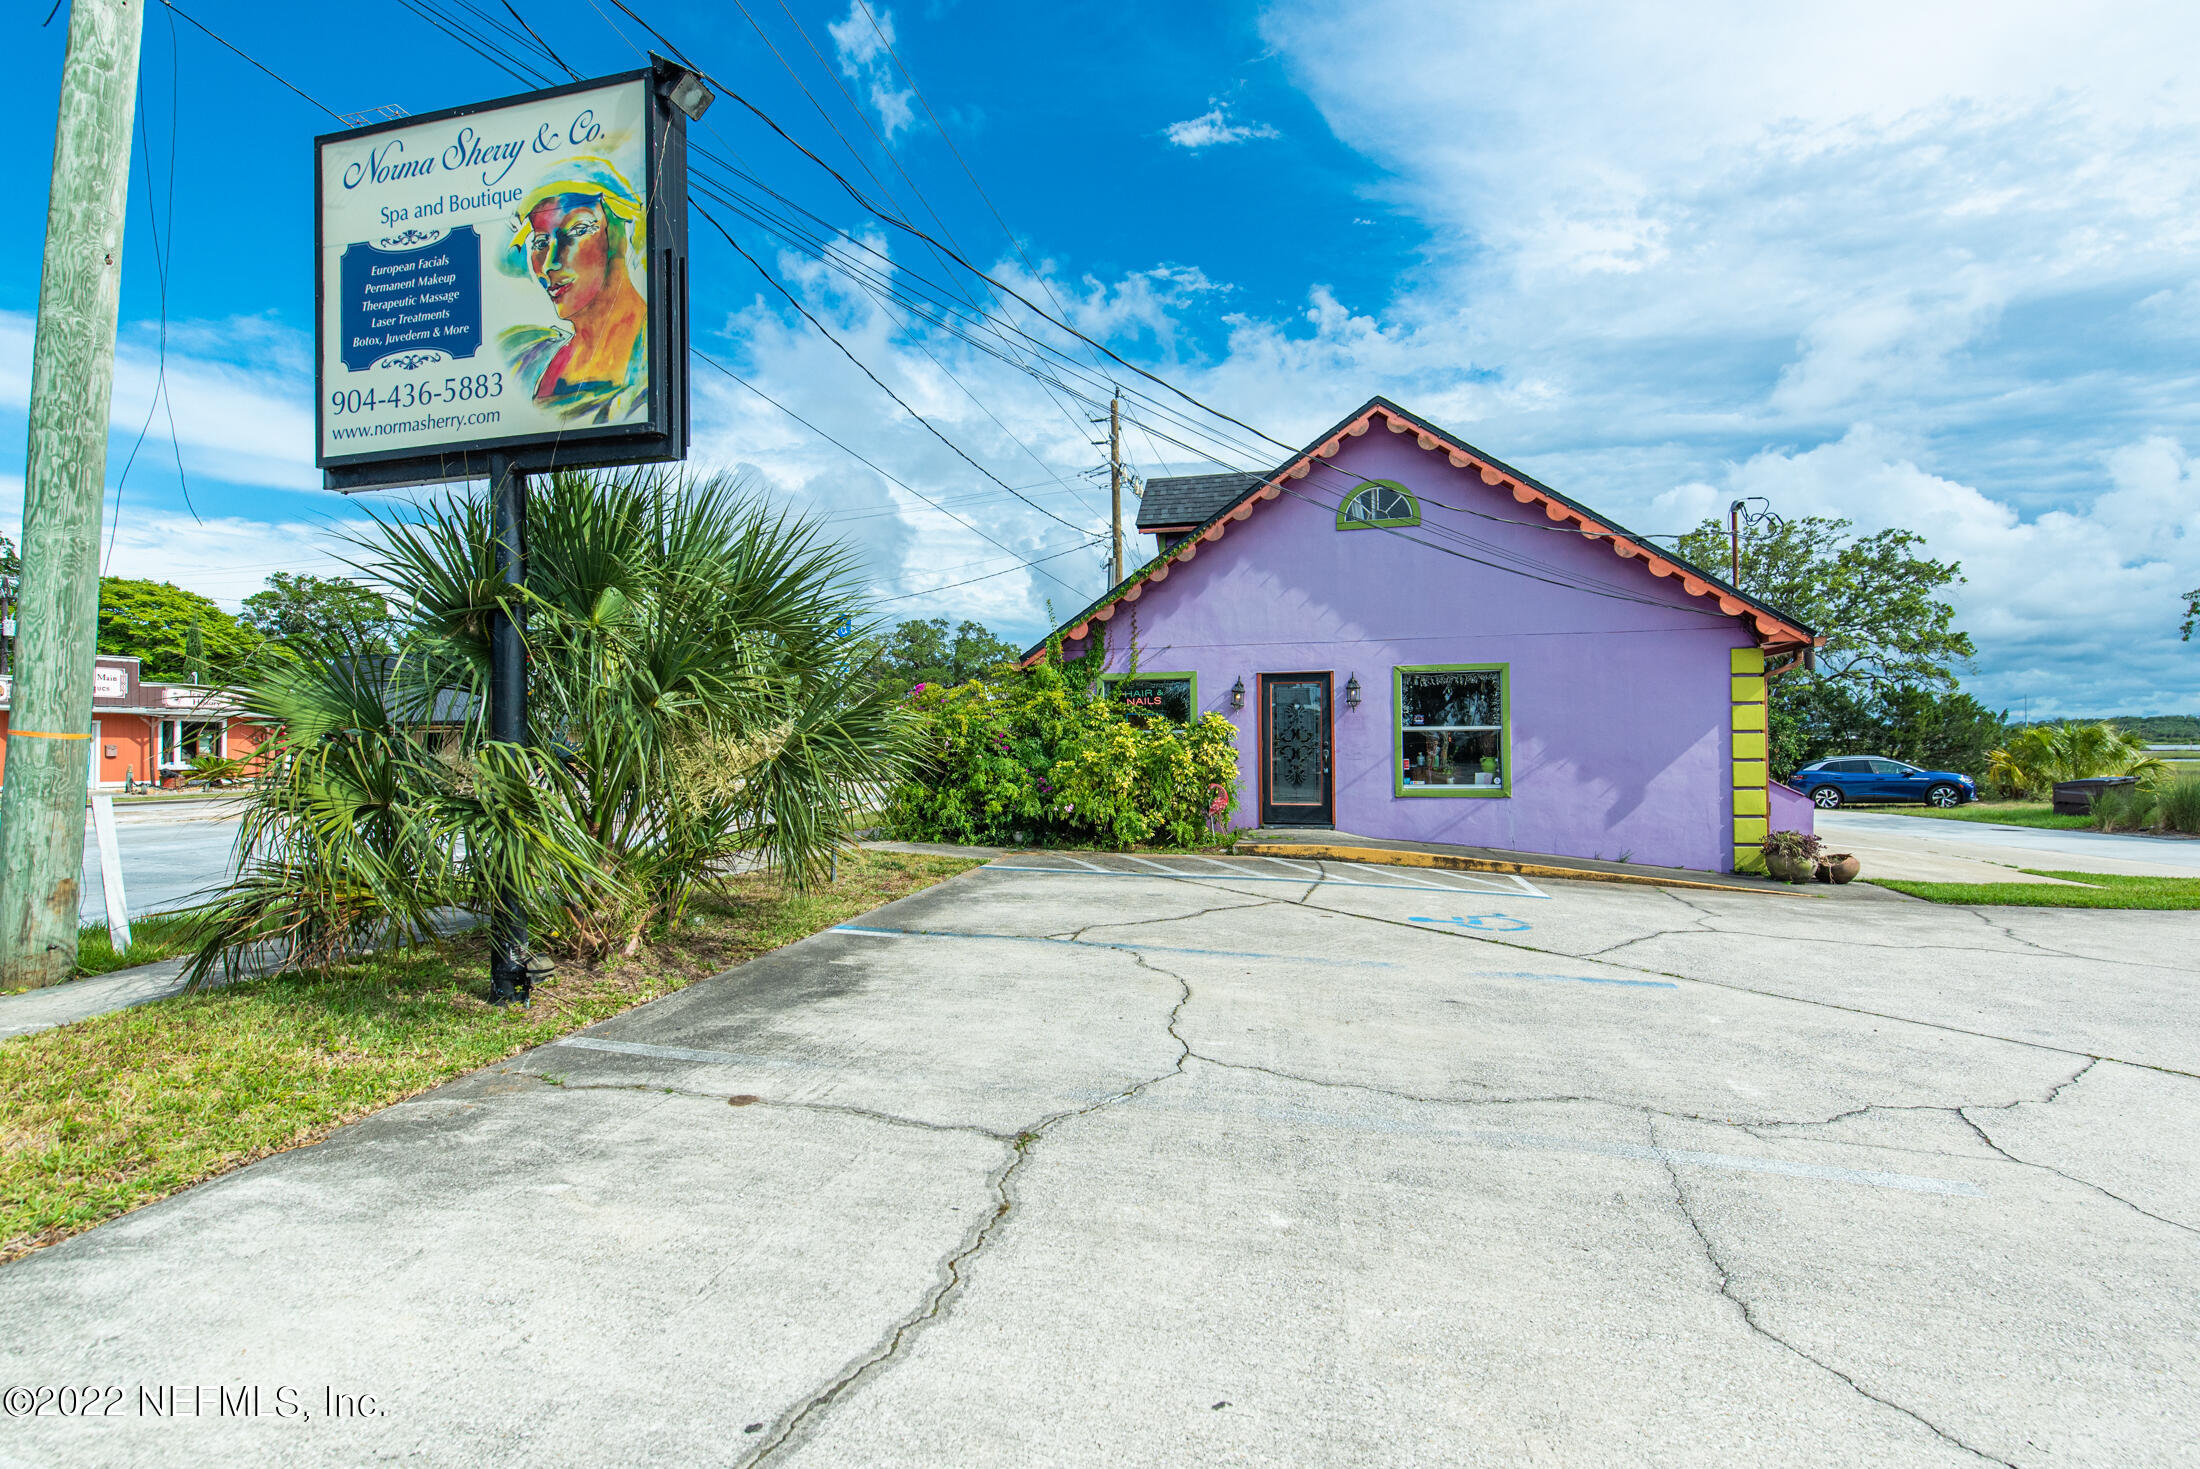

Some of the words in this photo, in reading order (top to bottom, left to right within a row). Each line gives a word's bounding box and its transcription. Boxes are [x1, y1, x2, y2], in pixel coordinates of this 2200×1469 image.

[343, 140, 435, 189] Norma
[442, 127, 525, 186] Sherry
[533, 122, 562, 154] &
[568, 109, 605, 145] Co.
[380, 206, 409, 228] Spa
[414, 196, 444, 219] and
[450, 187, 522, 213] Boutique
[371, 262, 416, 276] European
[418, 254, 450, 269] Facials
[364, 278, 416, 294] Permanent
[418, 273, 456, 286] Makeup
[362, 295, 417, 312] Therapeutic
[419, 291, 460, 303] Massage
[371, 317, 397, 328] Laser
[398, 309, 450, 325] Treatments
[352, 336, 383, 348] Botox,
[385, 329, 430, 346] Juvederm
[432, 327, 441, 337] &
[443, 325, 470, 336] More
[331, 372, 503, 415] 904-436-5883
[332, 410, 501, 440] www.normasherry.com
[1124, 689, 1153, 698] HAIR
[1126, 696, 1163, 706] NAILS
